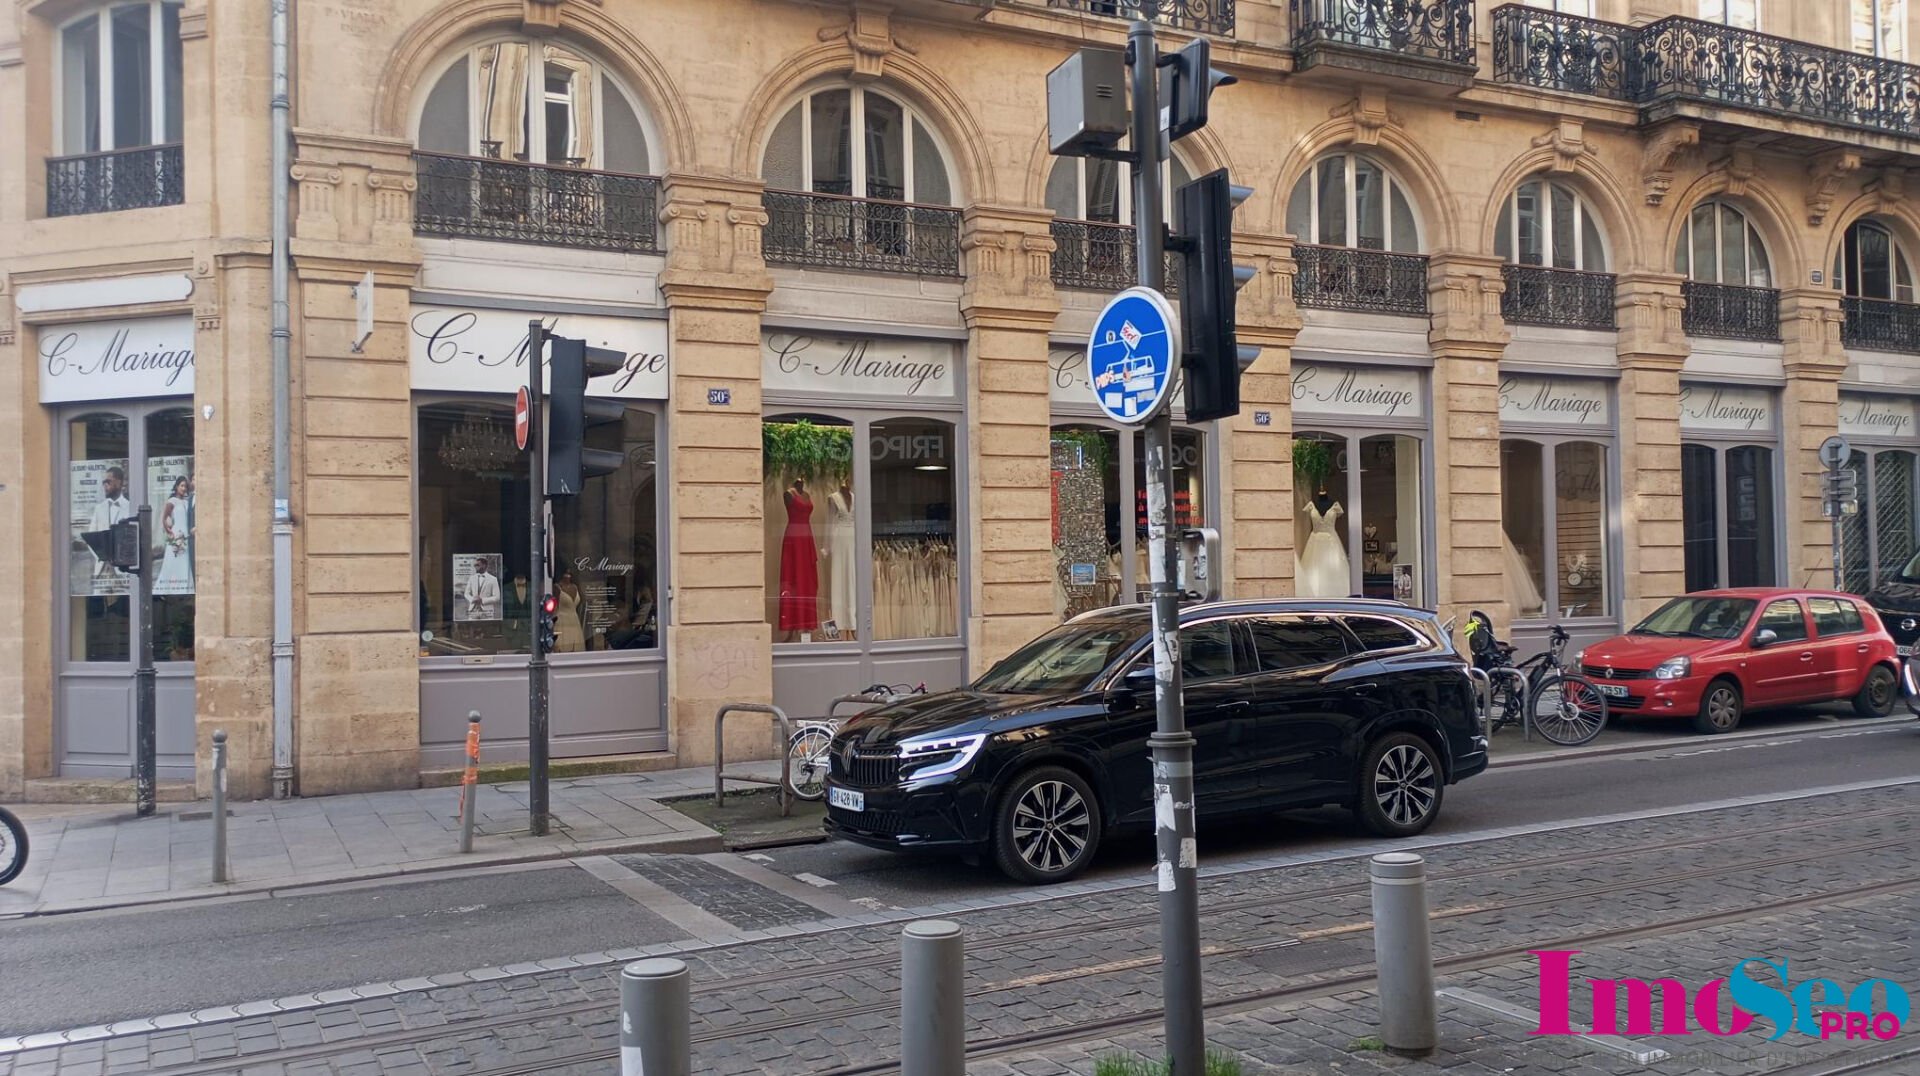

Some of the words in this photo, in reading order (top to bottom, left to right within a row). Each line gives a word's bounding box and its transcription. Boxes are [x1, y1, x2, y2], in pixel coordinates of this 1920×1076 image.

[39, 328, 195, 387] C-Mariag
[411, 310, 666, 393] C-Mge
[768, 334, 946, 396] C-Mariage
[1290, 366, 1413, 416] C-Mariage
[1838, 399, 1910, 437] -Mariage
[574, 557, 634, 576] C-Mariage
